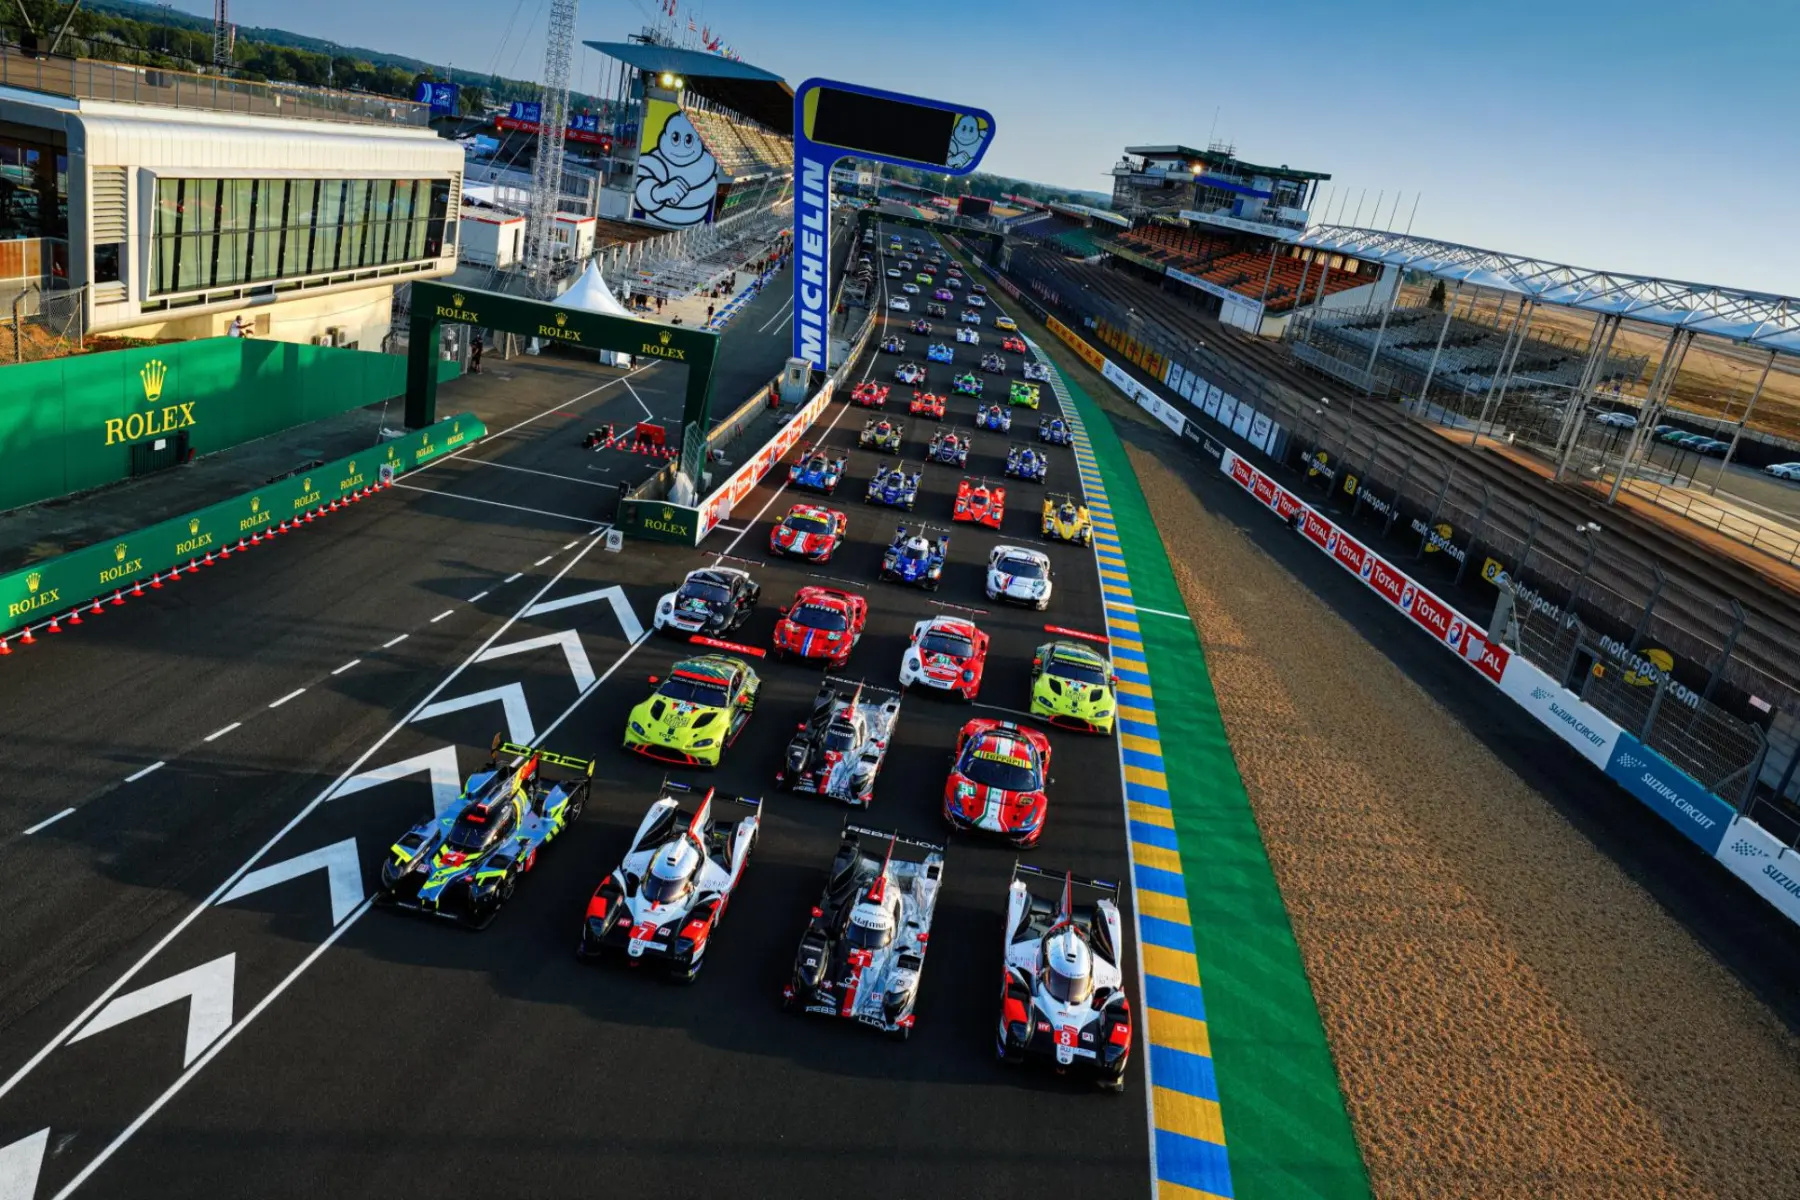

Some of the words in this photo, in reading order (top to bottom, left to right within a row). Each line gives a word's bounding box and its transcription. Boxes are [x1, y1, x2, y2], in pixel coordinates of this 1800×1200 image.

[800, 157, 824, 371] MICHELIN
[436, 305, 479, 323] ROLEX
[538, 324, 581, 342] ROLEX
[641, 342, 685, 361] ROLEX
[104, 401, 196, 446] ROLEX
[340, 474, 364, 490] ROLEX
[1235, 461, 1249, 481] TOTAL
[294, 490, 321, 509] ROLEX
[1255, 478, 1273, 499] TOTAL
[240, 511, 271, 531] ROLEX
[644, 518, 687, 537] ROLEX
[1308, 516, 1327, 541] TOTAL
[176, 532, 213, 555] ROLEX
[1338, 537, 1361, 563] TOTAL
[99, 558, 143, 584] ROLEX
[1373, 564, 1401, 597] TOTAL
[8, 588, 60, 618] ROLEX
[1416, 595, 1447, 632] TOTAL
[1467, 630, 1501, 673] TTAL
[1575, 722, 1606, 747] CIRCUIT
[1641, 772, 1678, 804] SUZUKA
[1674, 797, 1717, 830] CIRCUIT
[637, 926, 648, 938] 7
[857, 955, 865, 966] 1
[1061, 1031, 1071, 1046] 8
